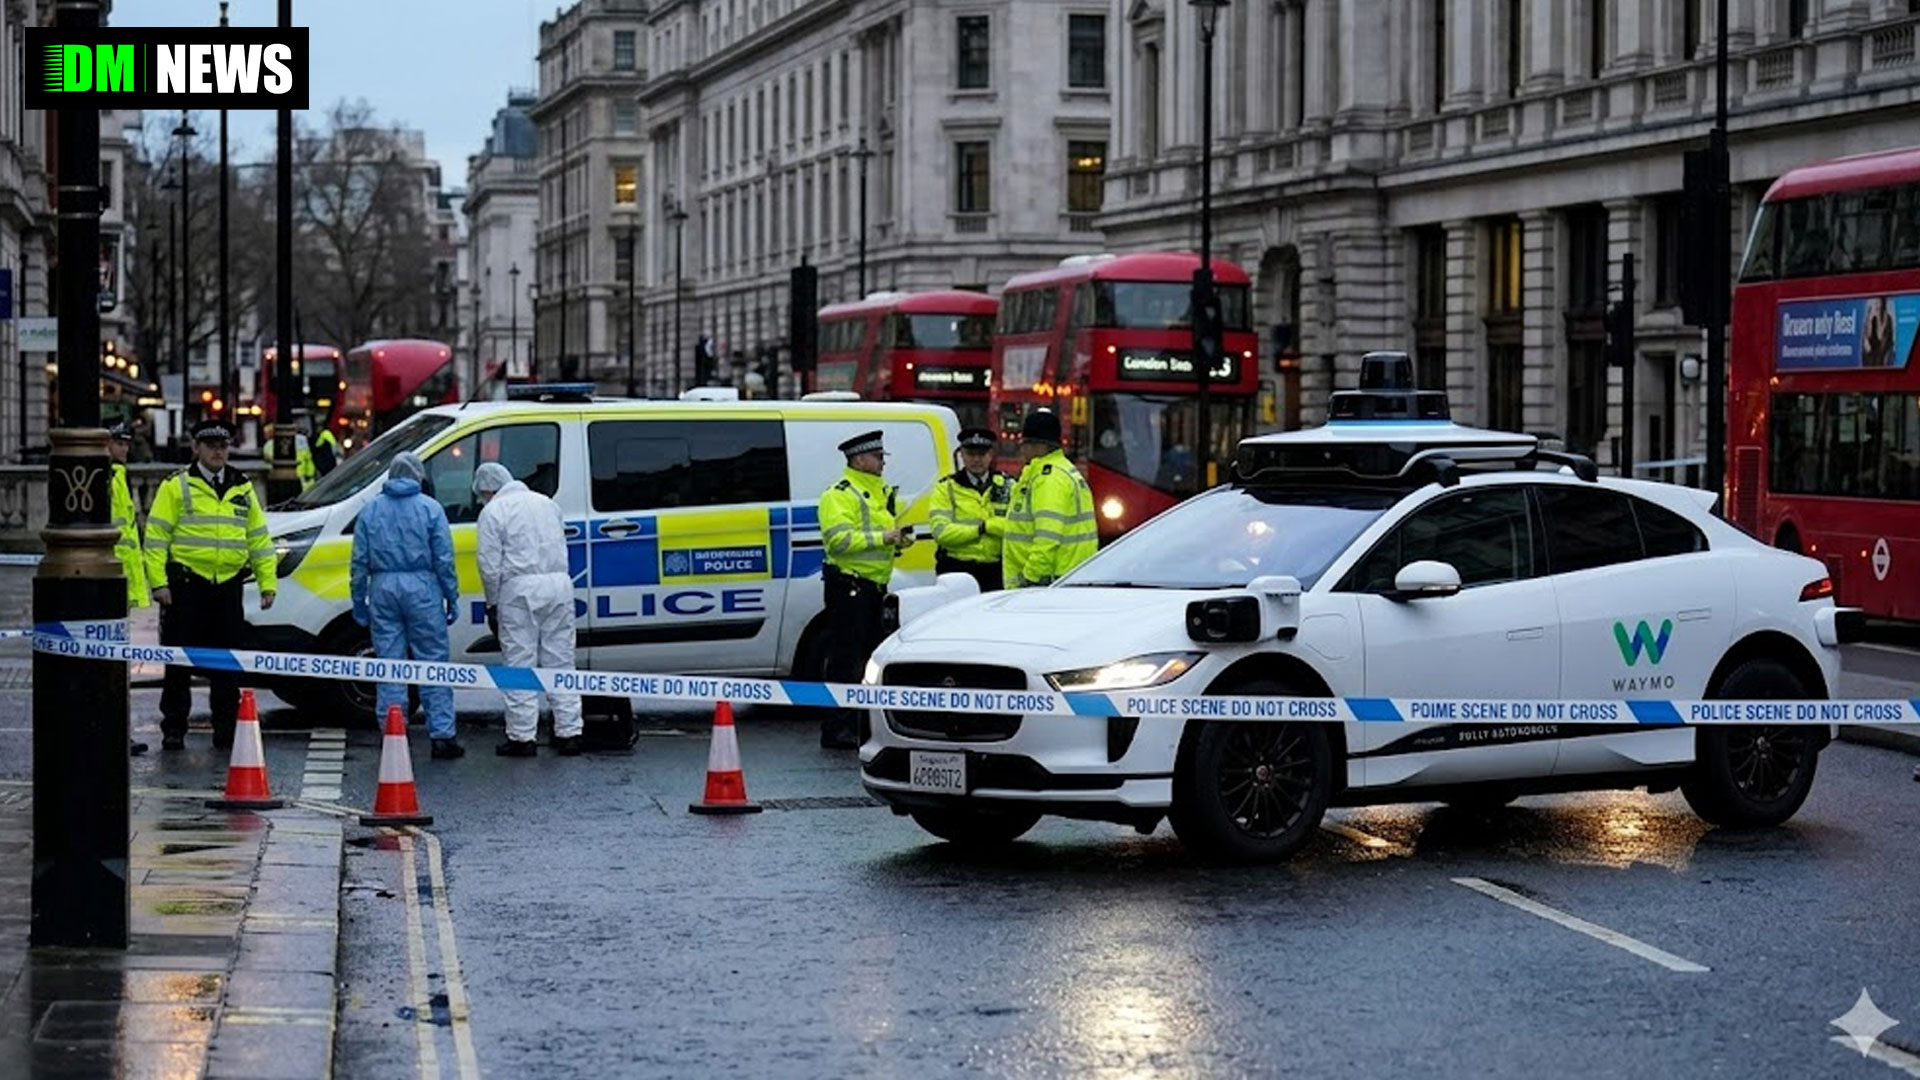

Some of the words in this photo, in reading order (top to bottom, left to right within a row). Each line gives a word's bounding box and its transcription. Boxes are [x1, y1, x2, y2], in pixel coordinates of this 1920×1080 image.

[704, 560, 753, 572] POLICE
[471, 589, 765, 625] LICE
[84, 643, 117, 659] NOT
[121, 646, 175, 663] CROSS
[254, 655, 307, 673] POLICE
[311, 660, 360, 677] SCENE
[365, 662, 386, 679] DO
[392, 664, 422, 681] NOT
[426, 666, 478, 684] CROSS
[554, 673, 606, 691] POLICE
[610, 677, 659, 694] SCENE
[663, 679, 683, 695] DO
[688, 681, 718, 697] NOT
[722, 682, 773, 700] CROSS
[1613, 675, 1675, 692] WAYMO
[847, 689, 897, 705] POLICE
[900, 691, 947, 708] SCENE
[951, 693, 970, 709] DO
[974, 694, 1004, 710] NOT
[1007, 695, 1055, 712] CROSS
[1128, 698, 1177, 714] POLICE
[1181, 699, 1227, 715] SCENE
[1232, 701, 1251, 716] DO
[1256, 701, 1284, 717] NOT
[1289, 701, 1337, 718] CROSS
[1461, 703, 1507, 720] SCENE
[1512, 704, 1531, 720] DO
[1537, 704, 1565, 720] NOT
[1570, 704, 1618, 720] CROSS
[1691, 704, 1742, 721] POLICE
[1746, 704, 1792, 721] SCENE
[1797, 705, 1817, 721] DO
[1821, 705, 1850, 721] NOT
[1854, 705, 1903, 721] CROSS
